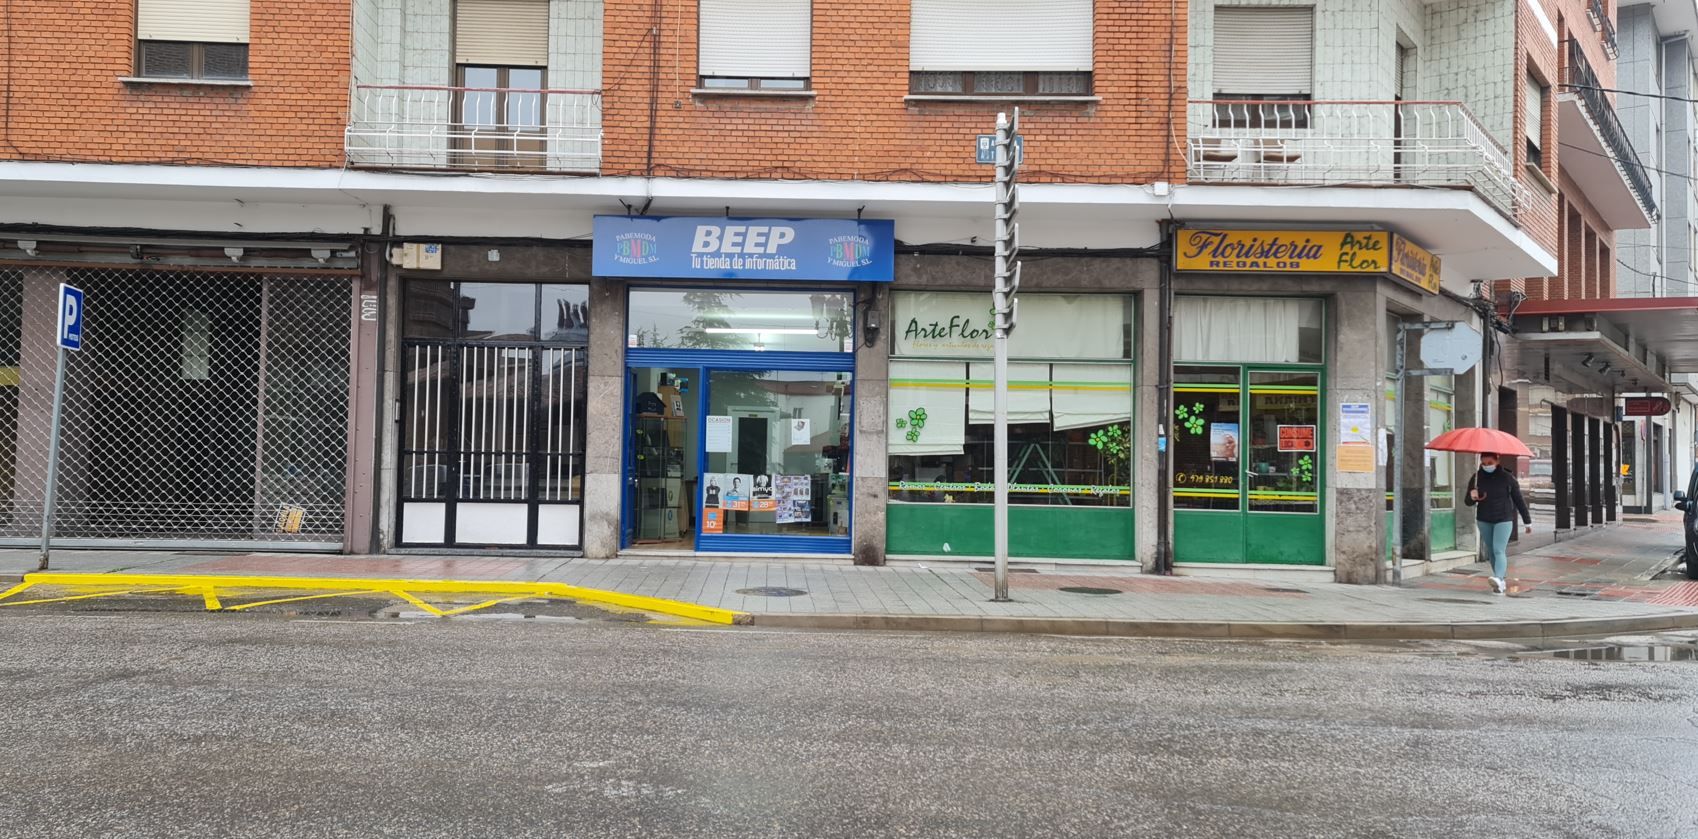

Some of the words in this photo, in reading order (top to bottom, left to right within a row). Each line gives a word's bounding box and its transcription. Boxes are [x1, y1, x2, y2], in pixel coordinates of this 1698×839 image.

[691, 225, 795, 254] BEEP
[1183, 230, 1323, 260] Floristeria
[1339, 231, 1383, 252] Arte
[691, 254, 701, 269] Tu
[703, 255, 730, 270] tienda
[732, 254, 743, 270] de
[745, 255, 797, 270] informática
[1209, 260, 1301, 269] REGALOS
[1336, 252, 1381, 270] Flor
[63, 293, 77, 339] P
[904, 315, 992, 341] ArteFlor
